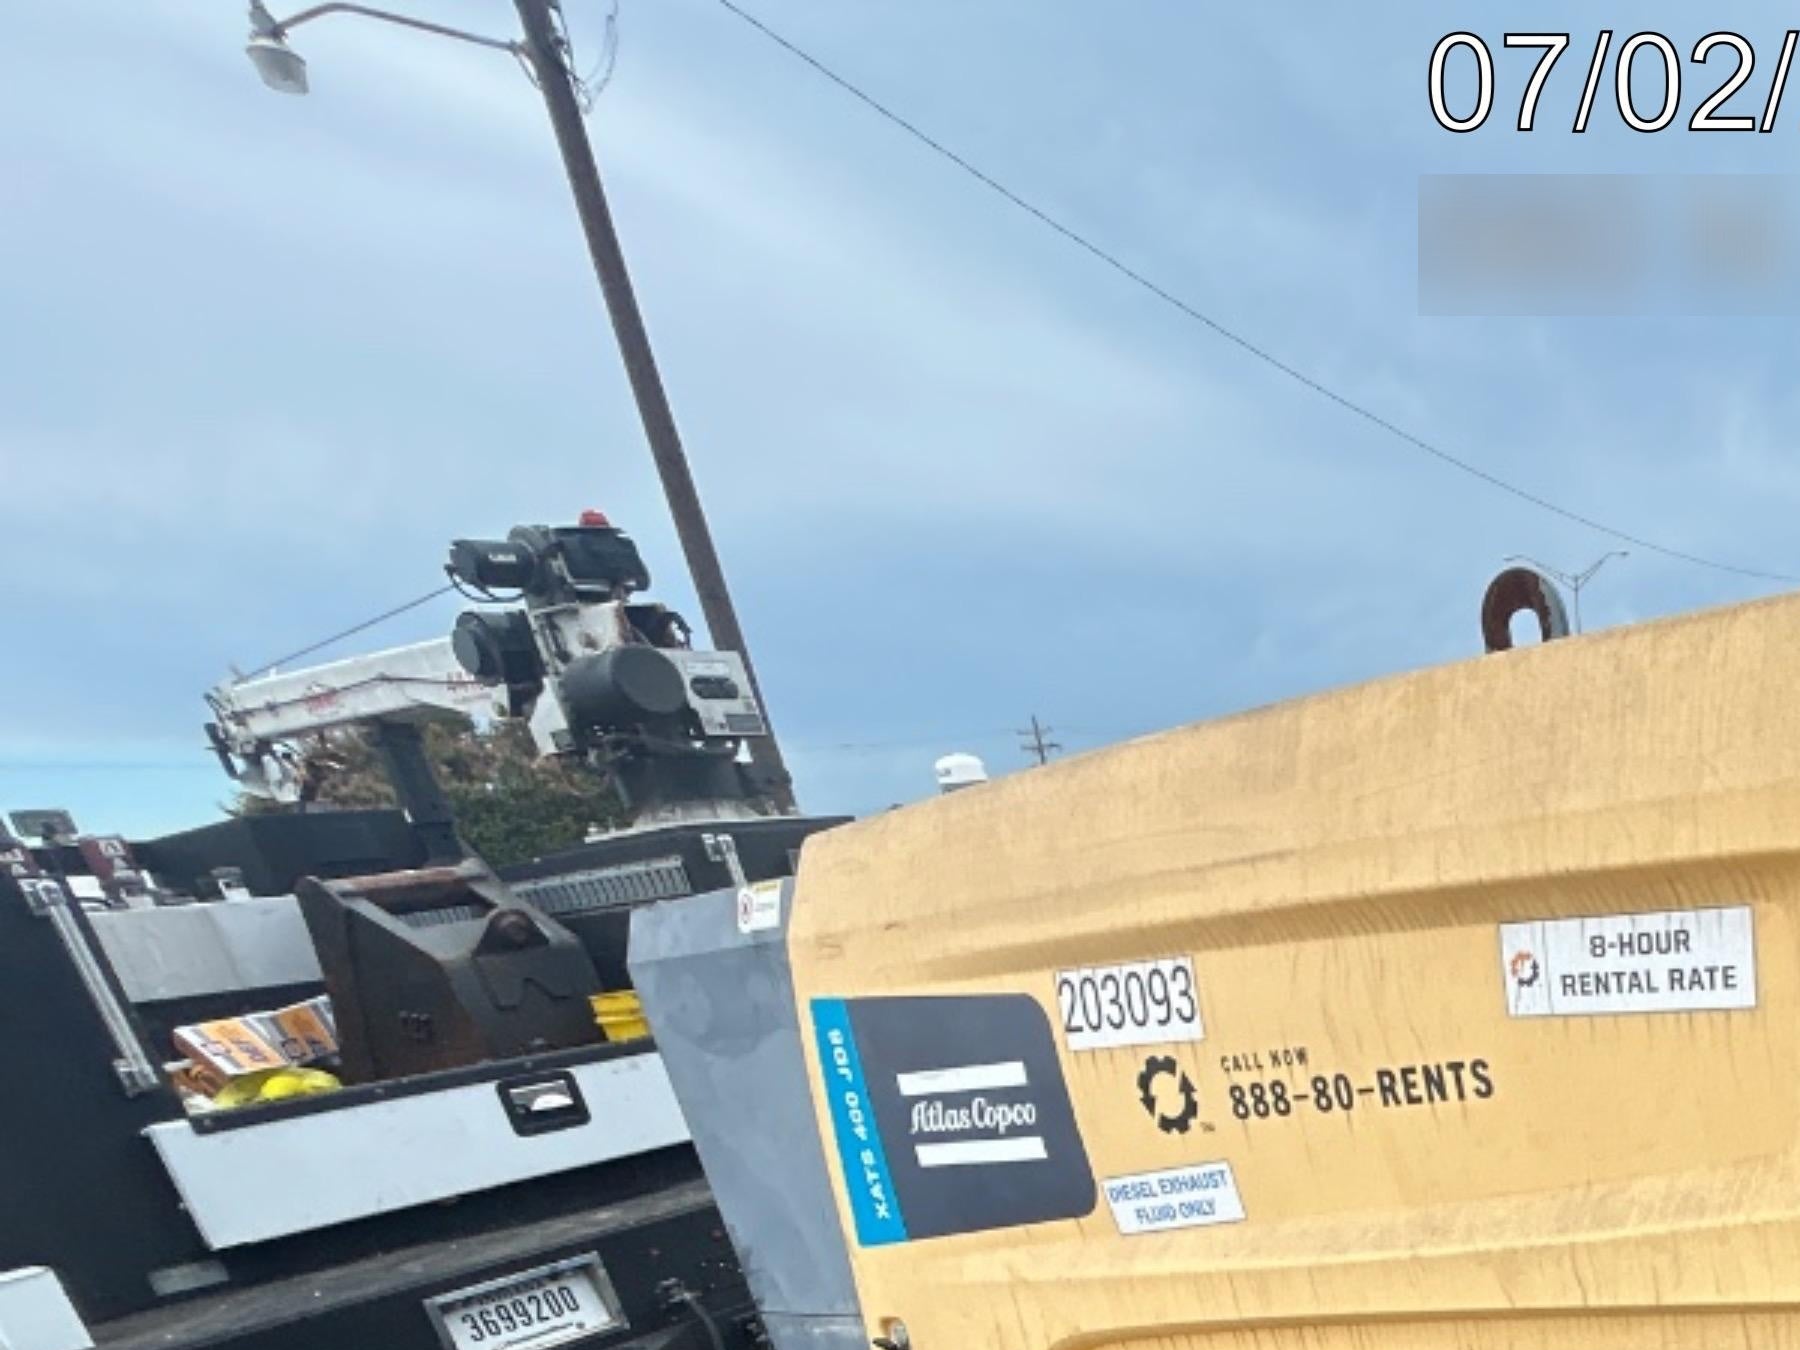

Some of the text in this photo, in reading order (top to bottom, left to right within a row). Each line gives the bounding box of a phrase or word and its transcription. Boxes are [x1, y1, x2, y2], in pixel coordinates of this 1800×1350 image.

[1589, 929, 1691, 958] 8-HOUR
[1058, 965, 1196, 1033] 203093
[1560, 965, 1737, 997] RENTAL RATE
[1220, 1047, 1309, 1073] CALL NOW
[1228, 1058, 1494, 1120] 888-80-RENTS
[844, 1091, 868, 1141] 400
[910, 1097, 1037, 1135] Atlas Copco
[860, 1149, 891, 1220] XATS
[1108, 1169, 1228, 1203] DIESEL EXHAUST
[1134, 1196, 1216, 1224] FLUID ONLY
[461, 1286, 580, 1342] 3699200
